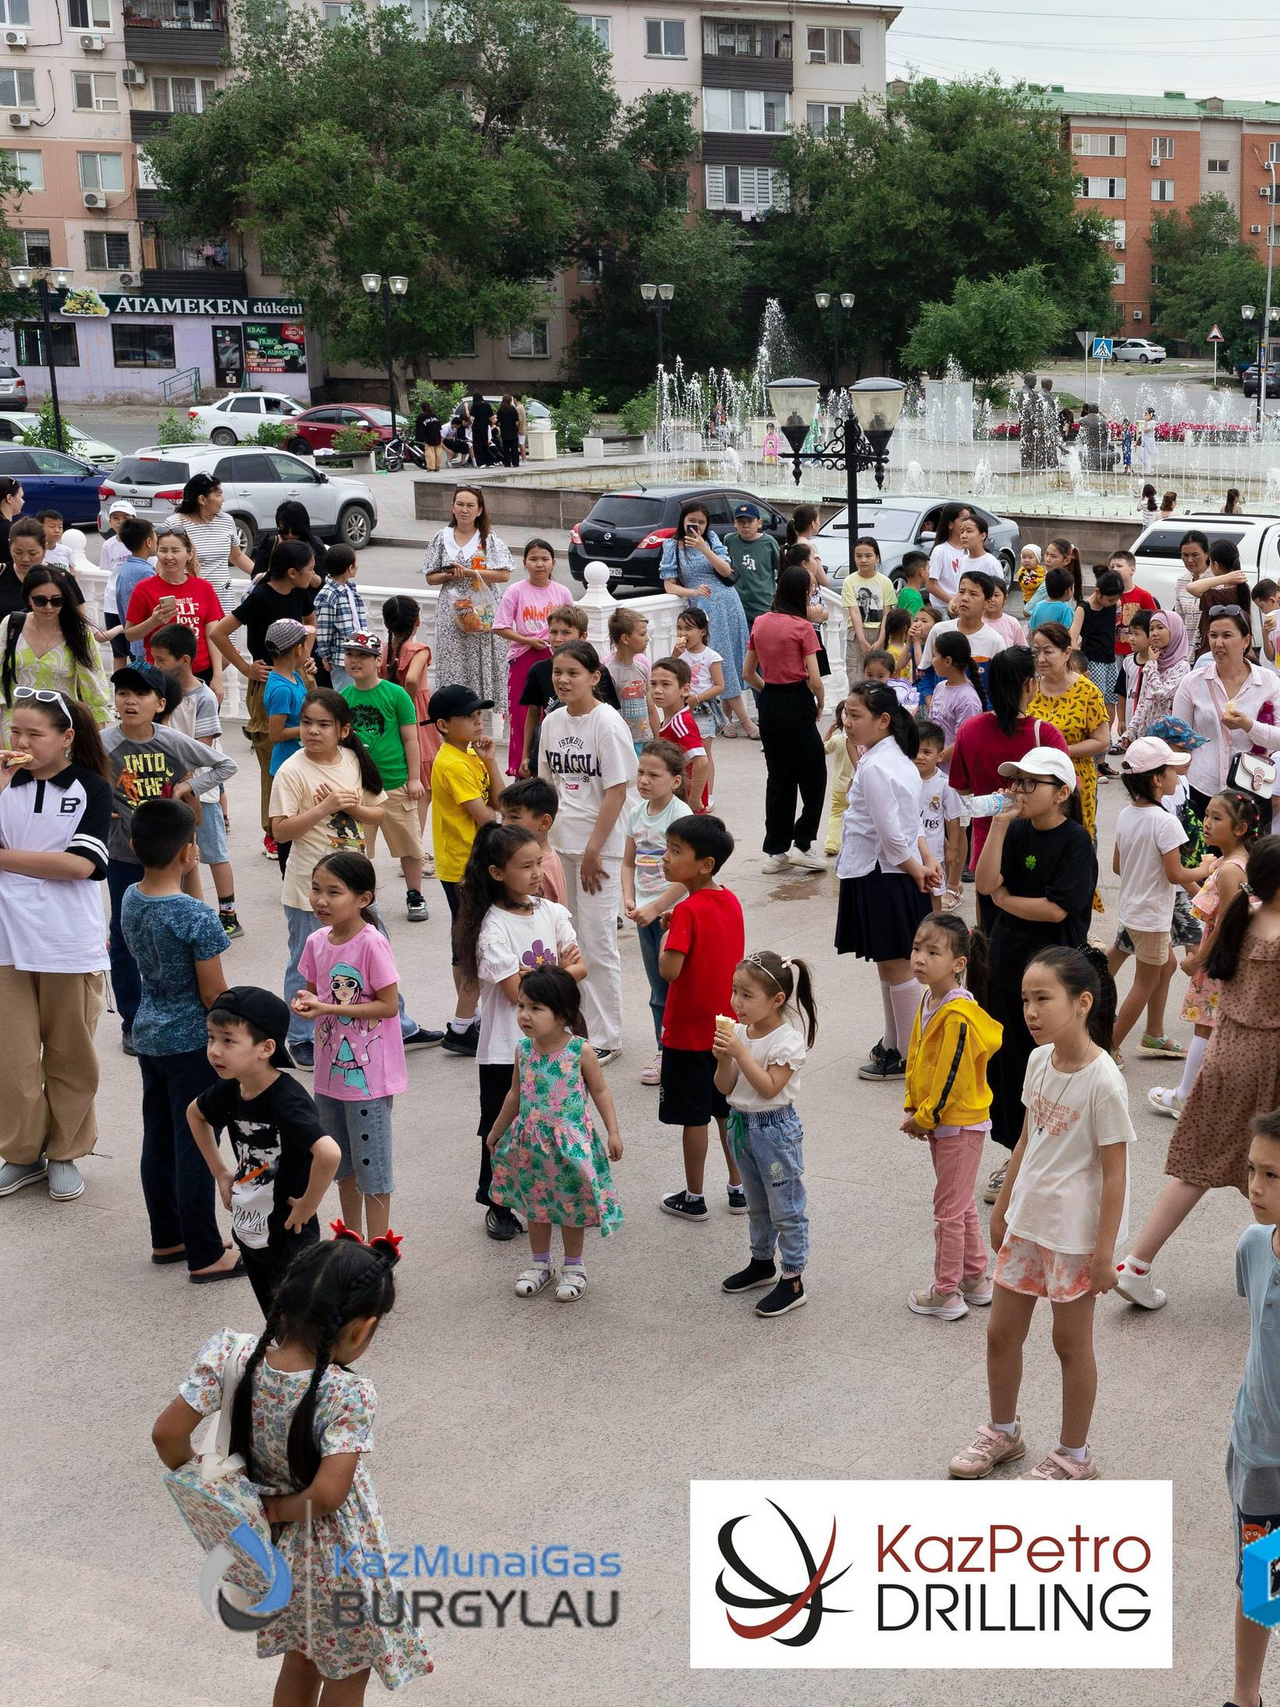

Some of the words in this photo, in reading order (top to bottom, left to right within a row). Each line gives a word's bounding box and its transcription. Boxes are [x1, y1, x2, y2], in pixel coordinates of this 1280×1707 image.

[115, 297, 248, 315] ATAMEKEN
[253, 302, 303, 315] dúkeni
[176, 615, 200, 625] love
[123, 752, 166, 774] INTO
[133, 777, 163, 797] THE
[60, 797, 81, 814] B
